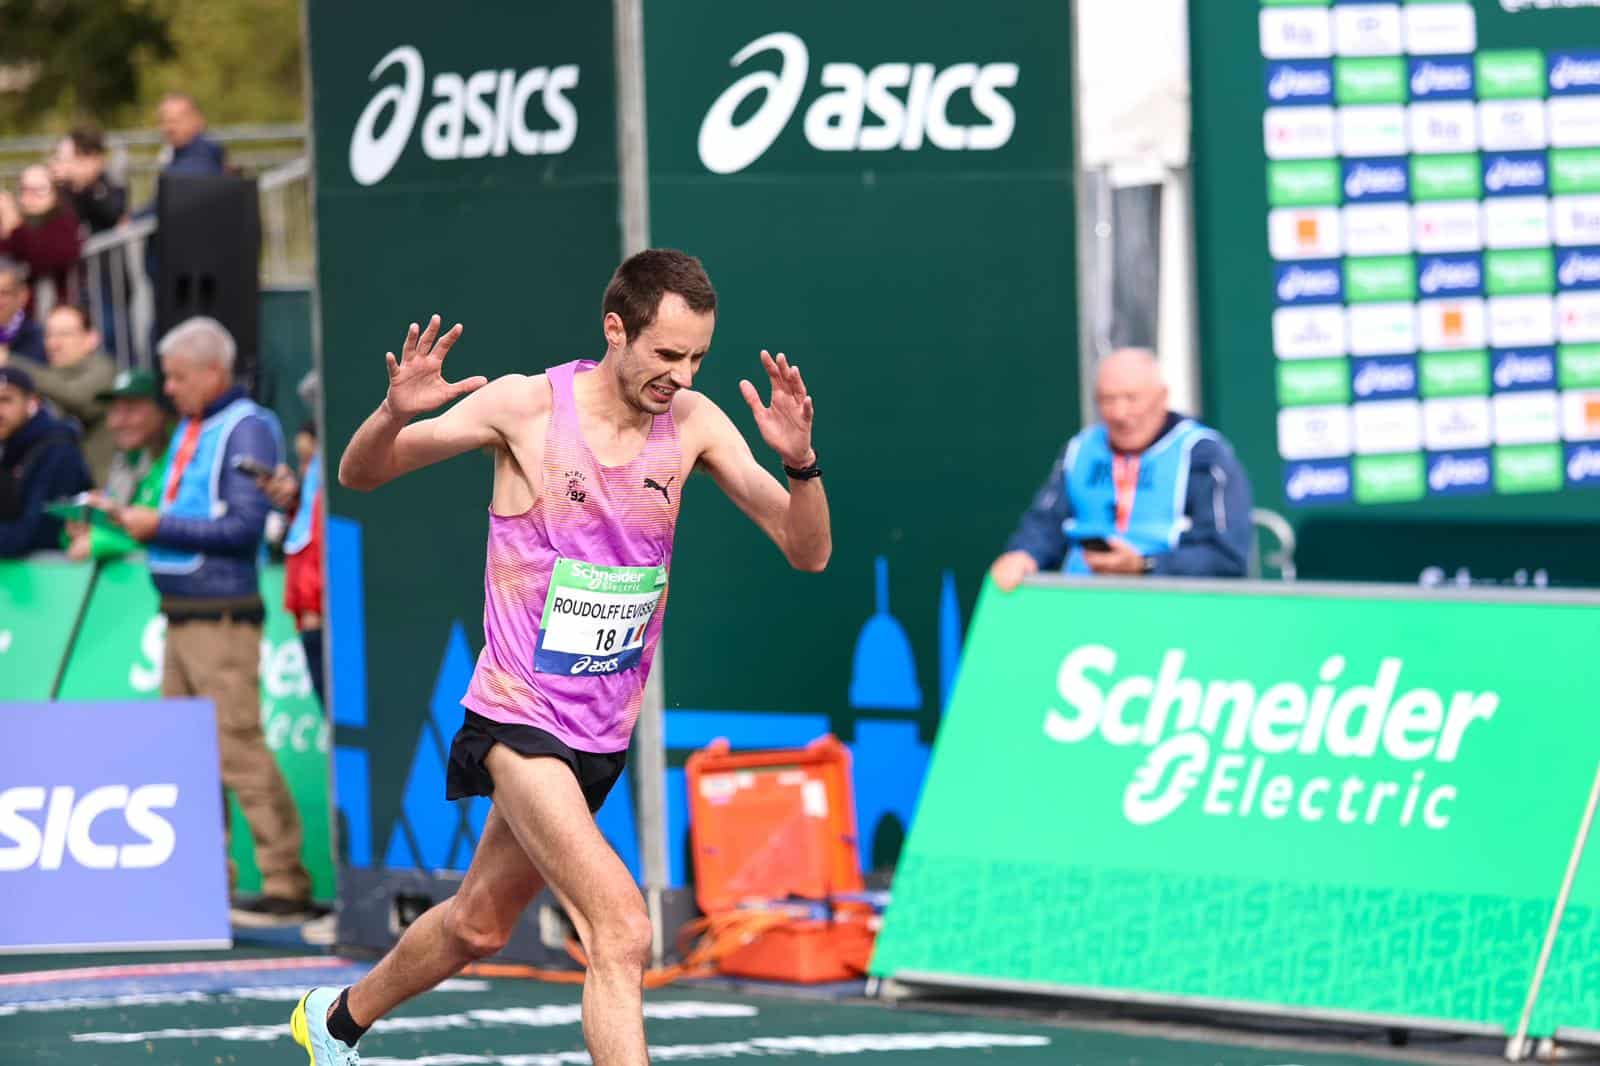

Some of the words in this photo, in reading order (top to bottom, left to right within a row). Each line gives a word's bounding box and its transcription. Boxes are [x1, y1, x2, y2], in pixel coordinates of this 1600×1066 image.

[421, 65, 580, 160] asics
[803, 62, 1020, 152] asics
[570, 490, 586, 503] 92
[571, 562, 645, 584] Schneider
[552, 597, 620, 619] ROUDOLFF
[595, 628, 617, 652] 18
[587, 657, 619, 673] asics
[1044, 644, 1499, 761] Schneider
[1203, 754, 1457, 829] Electric
[0, 783, 179, 872] SICS
